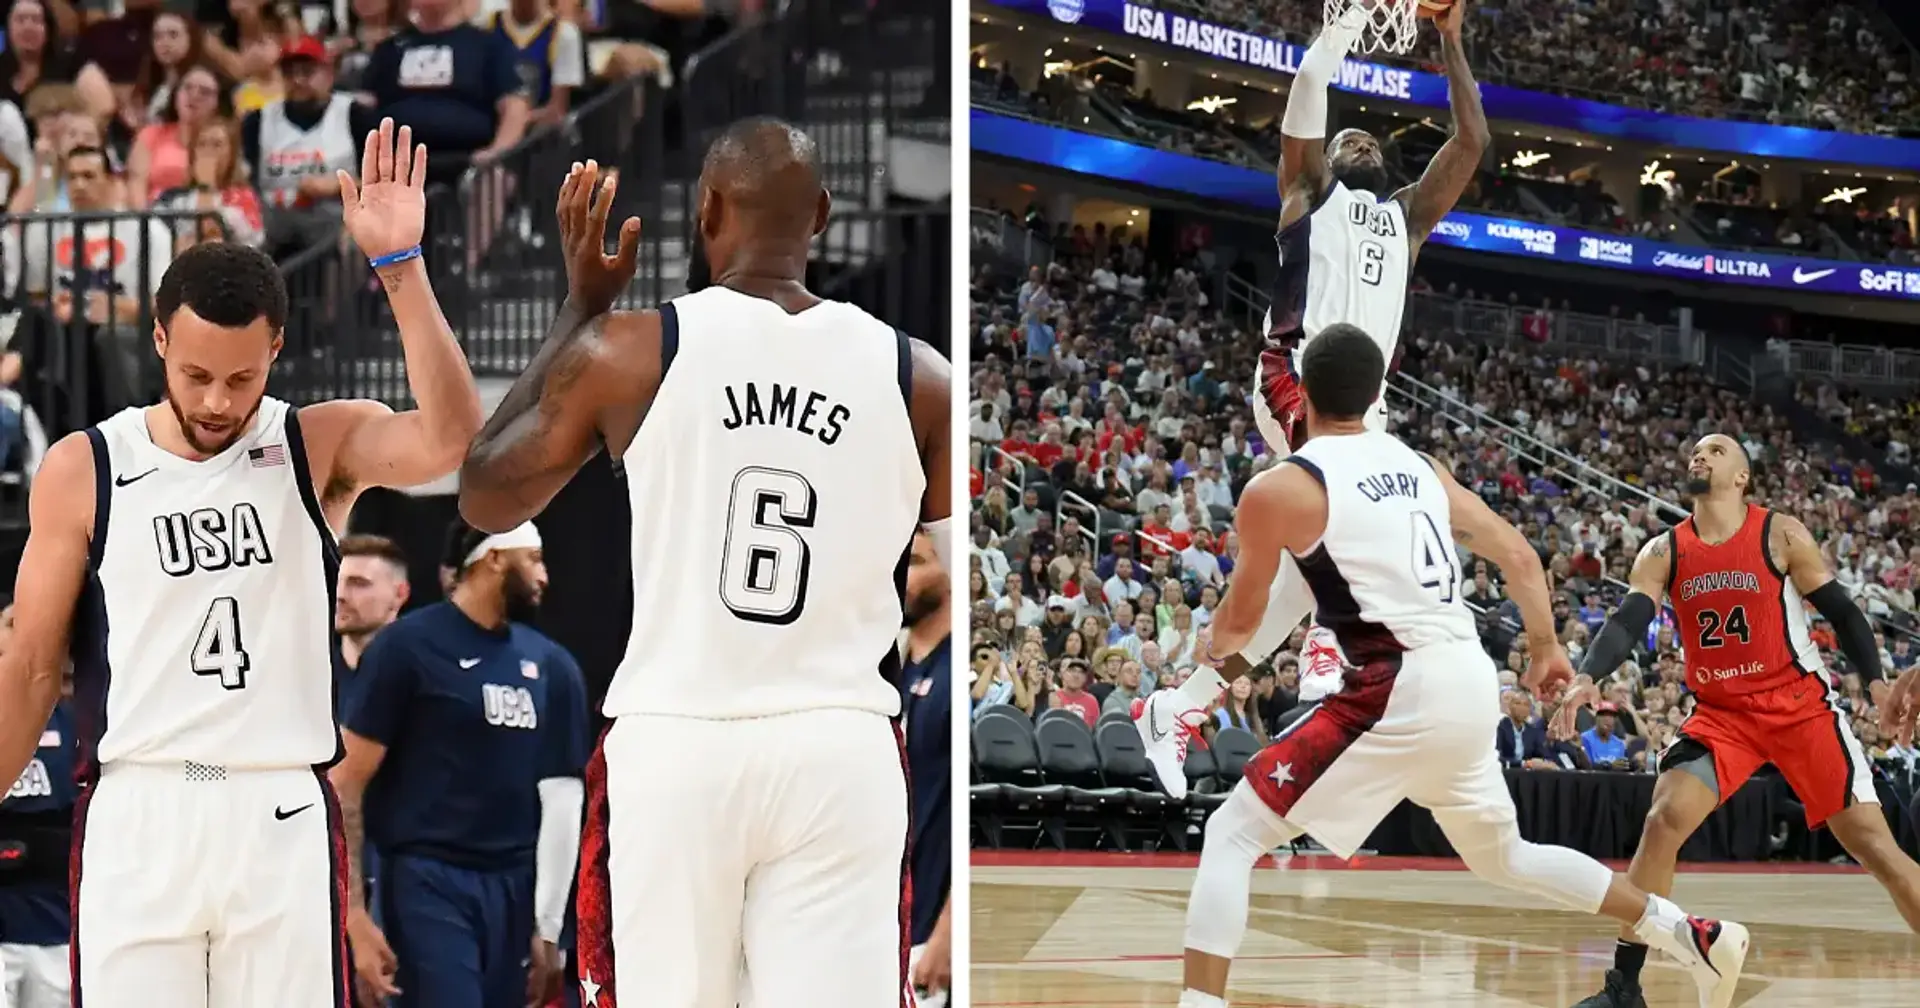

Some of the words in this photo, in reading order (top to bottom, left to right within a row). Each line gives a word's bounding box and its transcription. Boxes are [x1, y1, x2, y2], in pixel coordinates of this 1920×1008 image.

[1123, 4, 1167, 41] USA
[1172, 17, 1297, 73] BASKETBALL
[1329, 57, 1412, 99] WCASE
[1348, 202, 1397, 237] USA
[1487, 222, 1556, 244] KUMHO
[1358, 239, 1385, 286] 6
[1715, 260, 1771, 278] ULTRA
[1860, 268, 1903, 292] SoFi
[722, 382, 851, 446] JAMES
[1356, 472, 1419, 503] CURRY
[153, 502, 273, 577] USA
[718, 465, 818, 625] 6
[1409, 510, 1456, 604] 4
[1681, 569, 1761, 602] CANADA
[190, 596, 251, 691] 4
[1696, 604, 1751, 649] 24
[1713, 666, 1739, 681] Sun
[1740, 660, 1765, 676] Life
[482, 683, 538, 730] USA
[4, 759, 52, 797] SA
